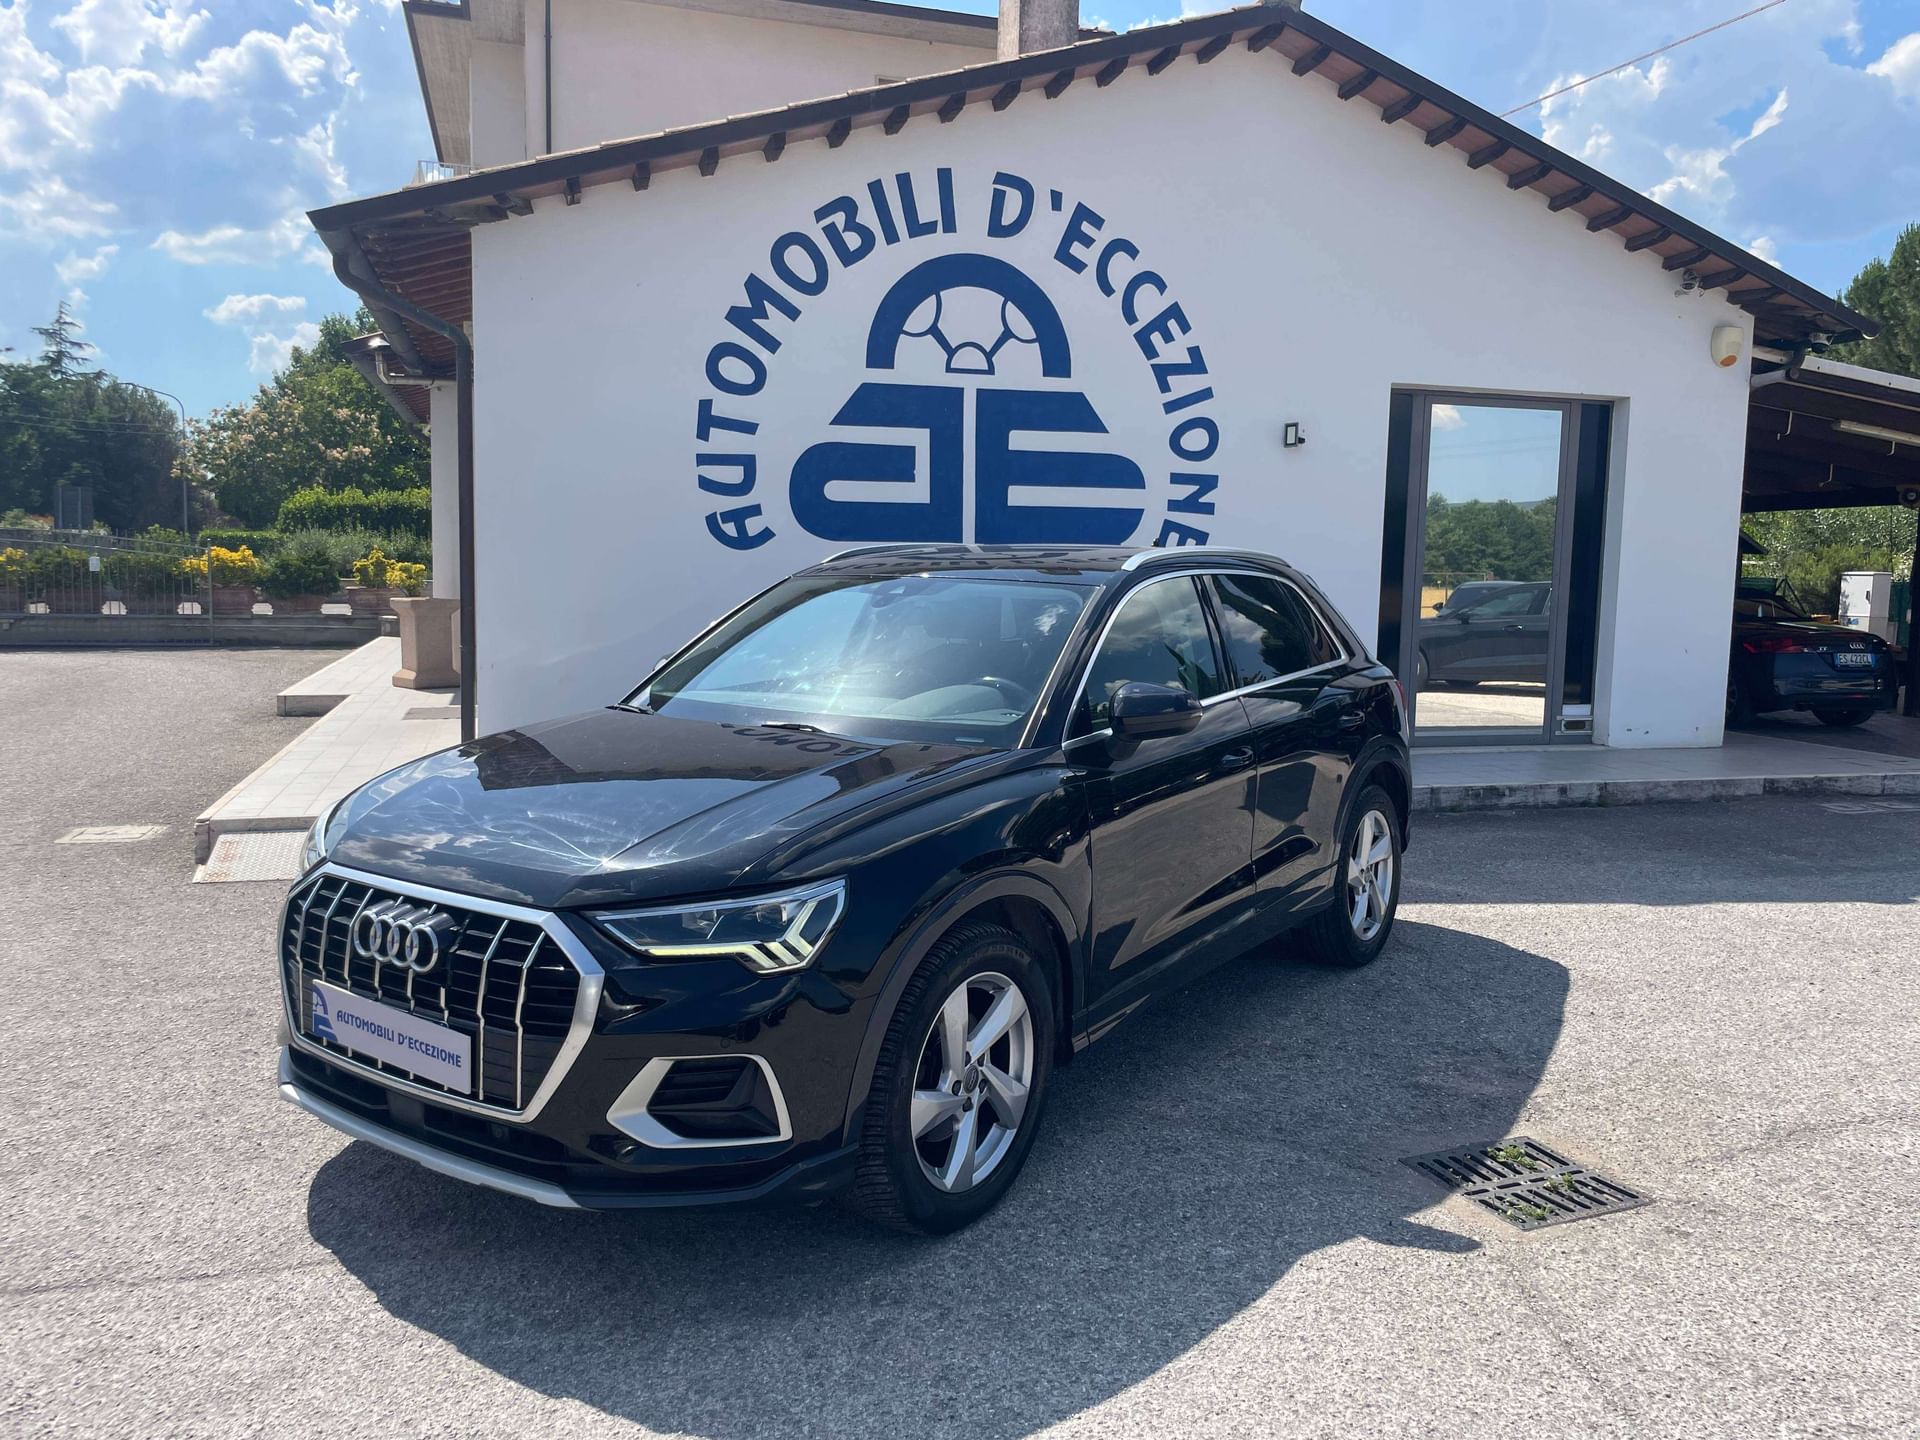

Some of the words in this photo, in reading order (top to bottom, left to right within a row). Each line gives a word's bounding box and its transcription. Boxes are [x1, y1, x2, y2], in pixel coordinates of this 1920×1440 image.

[695, 167, 957, 550] AUTOMOBILI
[987, 171, 1220, 547] D'ECCEZIONE
[336, 1009, 395, 1042] AUTOMOBILI
[397, 1033, 462, 1068] D'ECCEZIONE
